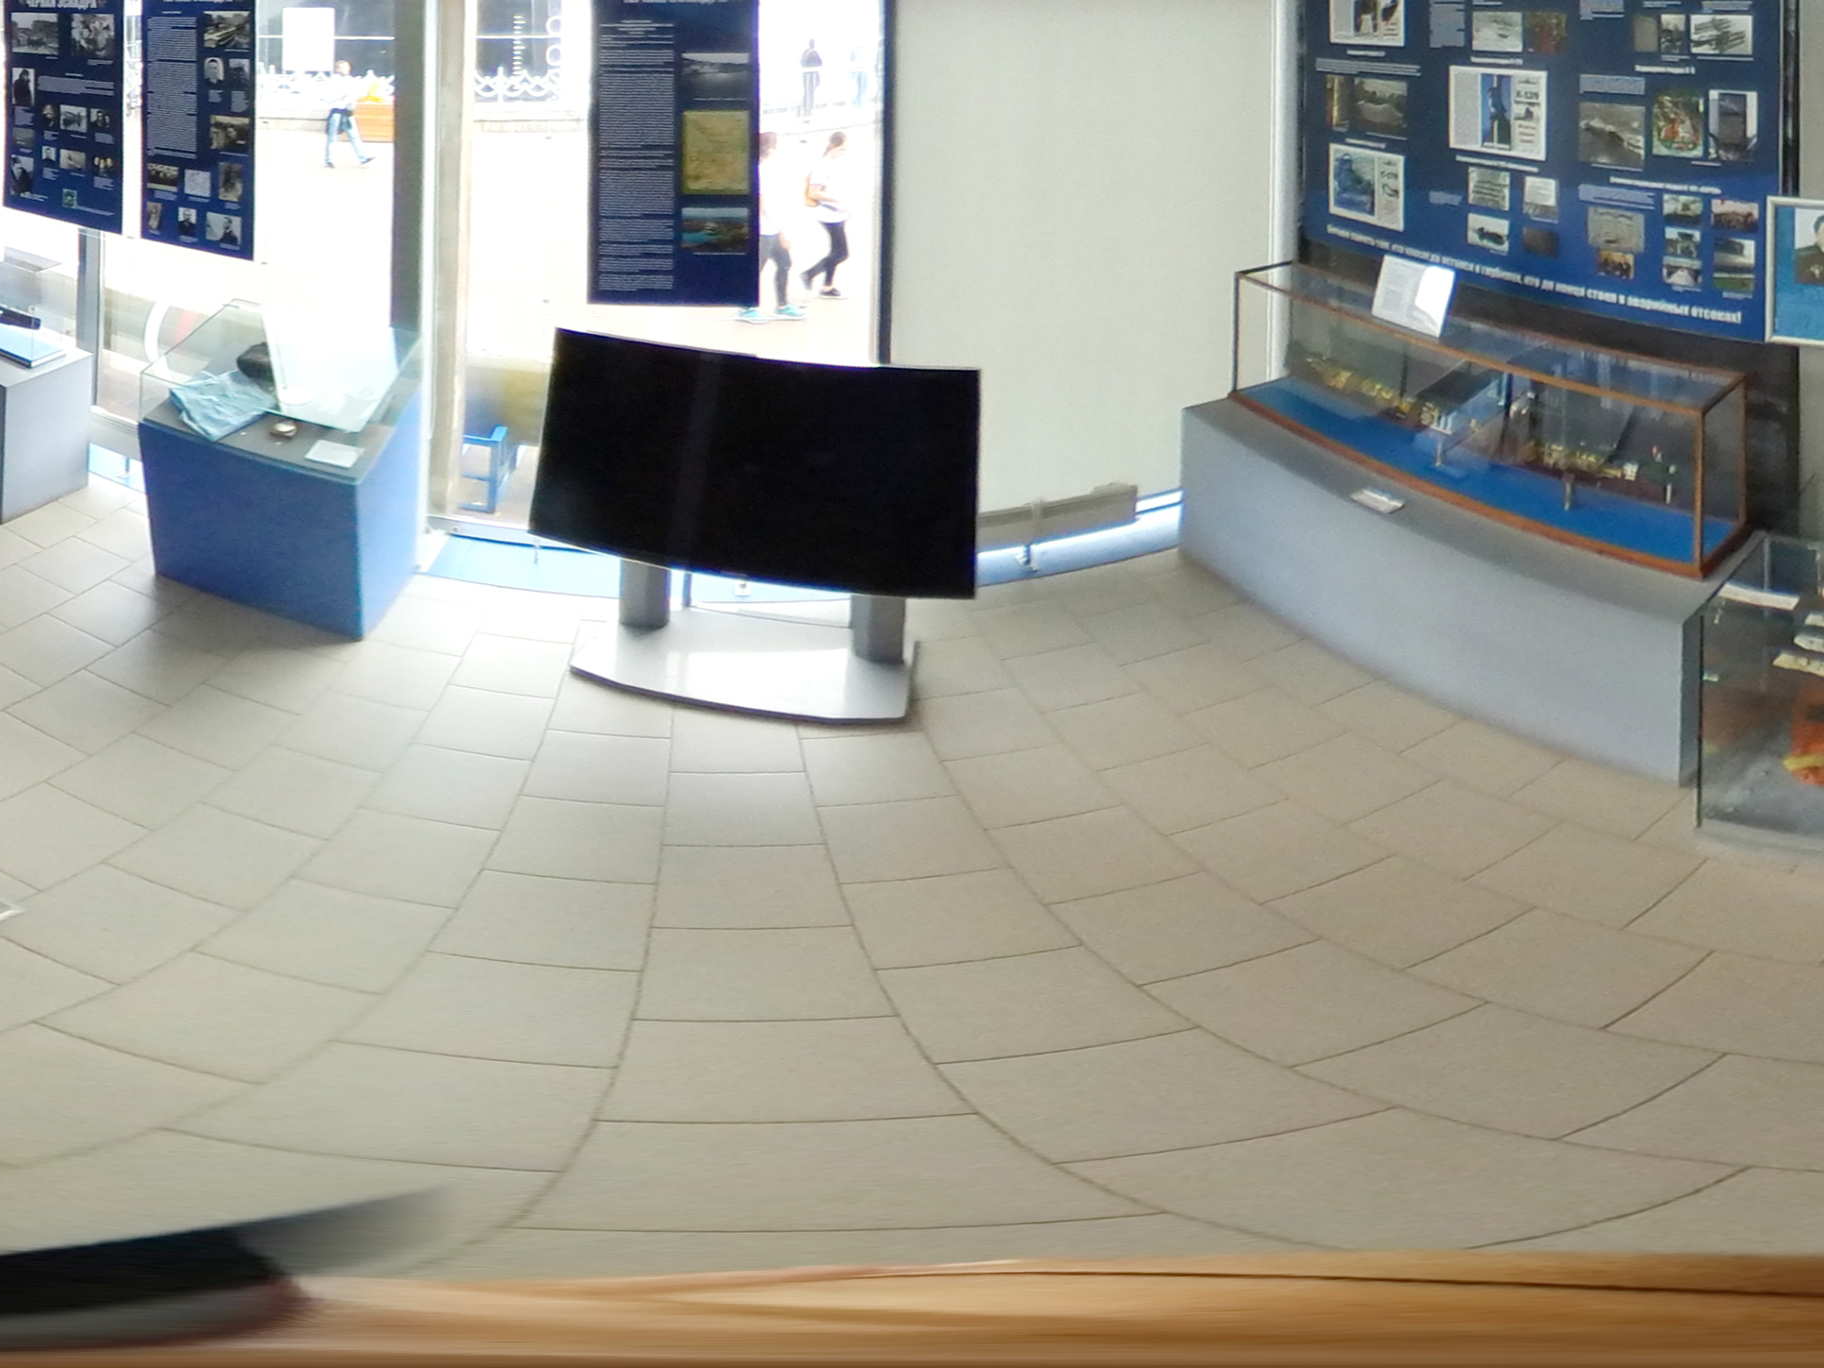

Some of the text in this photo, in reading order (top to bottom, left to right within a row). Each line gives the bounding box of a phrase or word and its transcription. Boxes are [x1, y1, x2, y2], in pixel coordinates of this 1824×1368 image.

[1540, 278, 1555, 291] до
[1586, 288, 1617, 305] стоял
[1626, 294, 1690, 316] аварийных
[1690, 305, 1743, 325] отсеках!
